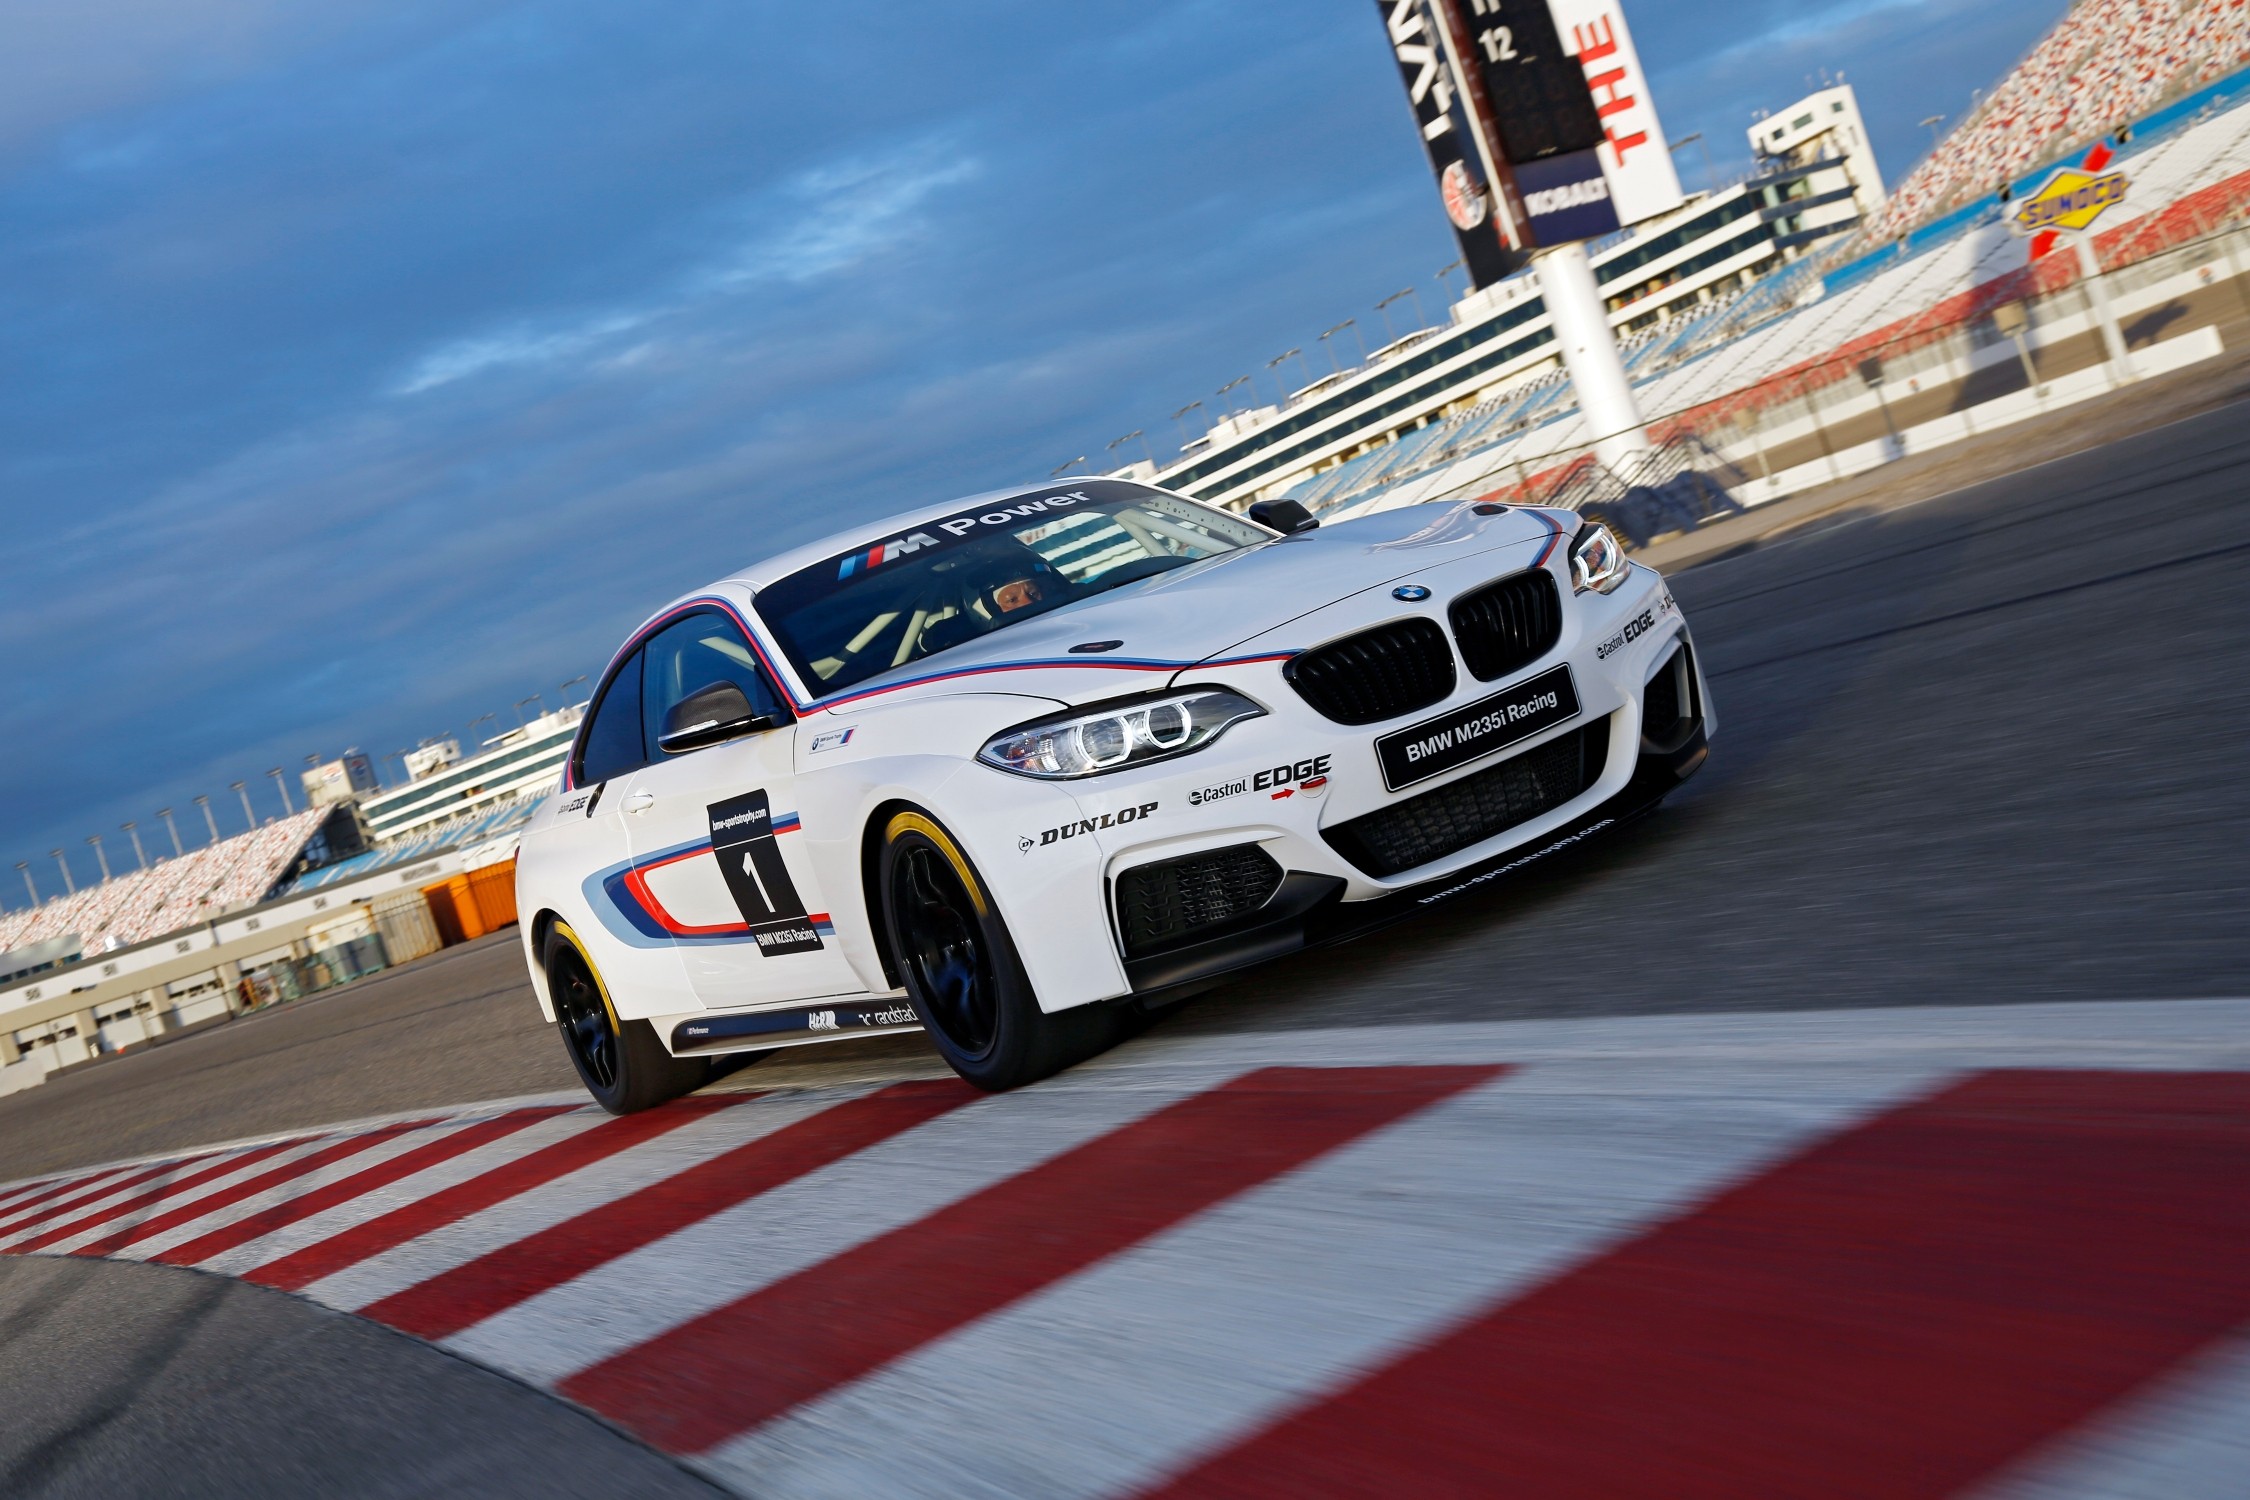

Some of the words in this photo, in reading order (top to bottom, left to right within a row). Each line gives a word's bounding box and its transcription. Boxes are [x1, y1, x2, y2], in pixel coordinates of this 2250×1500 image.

[1478, 25, 1518, 63] 12
[1573, 14, 1648, 168] THE
[2025, 177, 2122, 226] SUNOCO
[938, 490, 1091, 537] Power
[1603, 631, 1625, 656] Castrol
[1623, 608, 1656, 644] EDGE
[1405, 730, 1454, 763] BMW
[1454, 708, 1508, 744] M235i
[1507, 690, 1559, 724] Racing
[1203, 777, 1249, 802] Castrol
[1253, 753, 1333, 792] EDGE
[712, 808, 767, 831] bmw-sportstrophy.com
[1040, 801, 1159, 846] DUNLOP
[742, 851, 776, 913] 1
[756, 934, 774, 946] BMW
[773, 931, 794, 943] M235i
[793, 927, 818, 942] Racing
[874, 1004, 919, 1025] randstad
